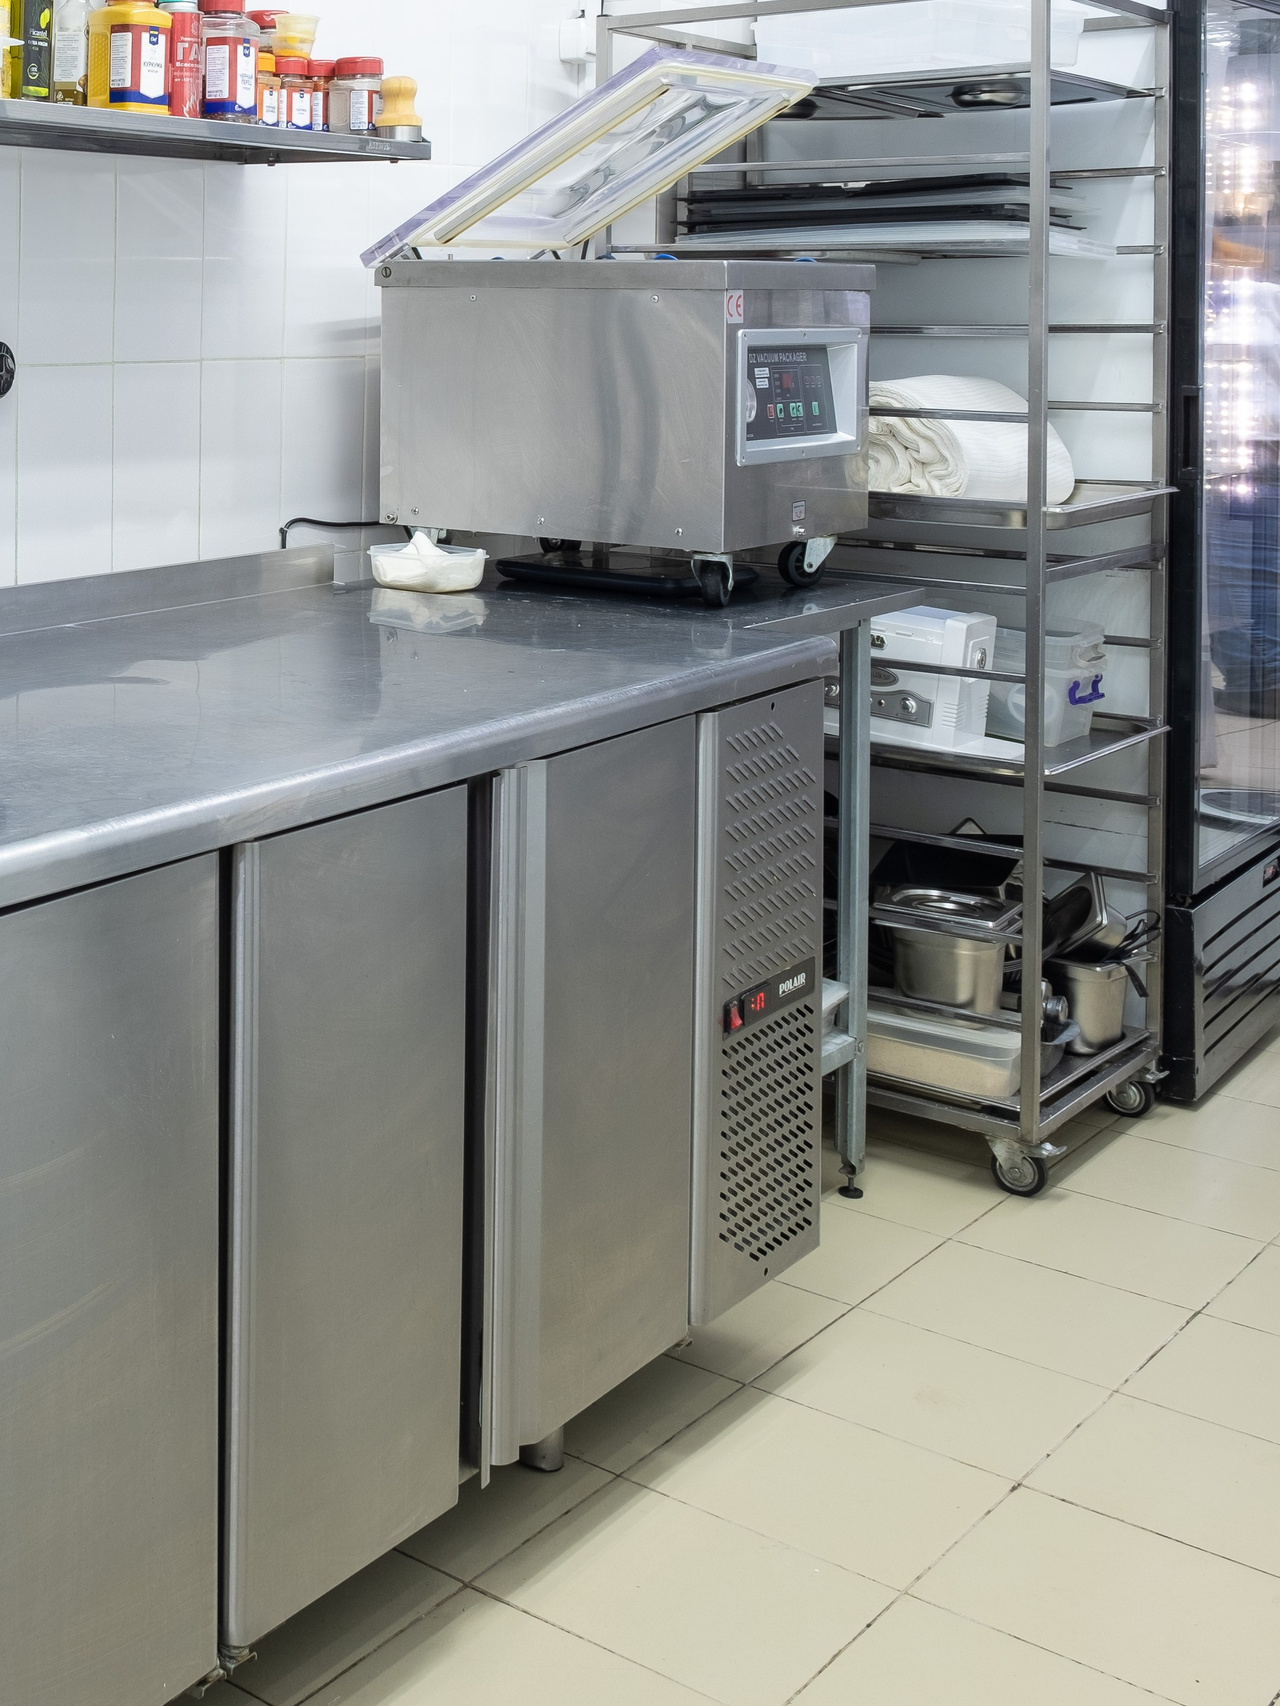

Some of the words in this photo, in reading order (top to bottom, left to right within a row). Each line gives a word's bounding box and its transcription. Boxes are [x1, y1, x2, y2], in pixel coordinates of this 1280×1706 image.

[727, 294, 742, 318] CE
[749, 353, 757, 363] DZ
[757, 353, 779, 363] VACUUM
[779, 352, 807, 362] PACKAGER
[779, 972, 806, 995] POLAIR
